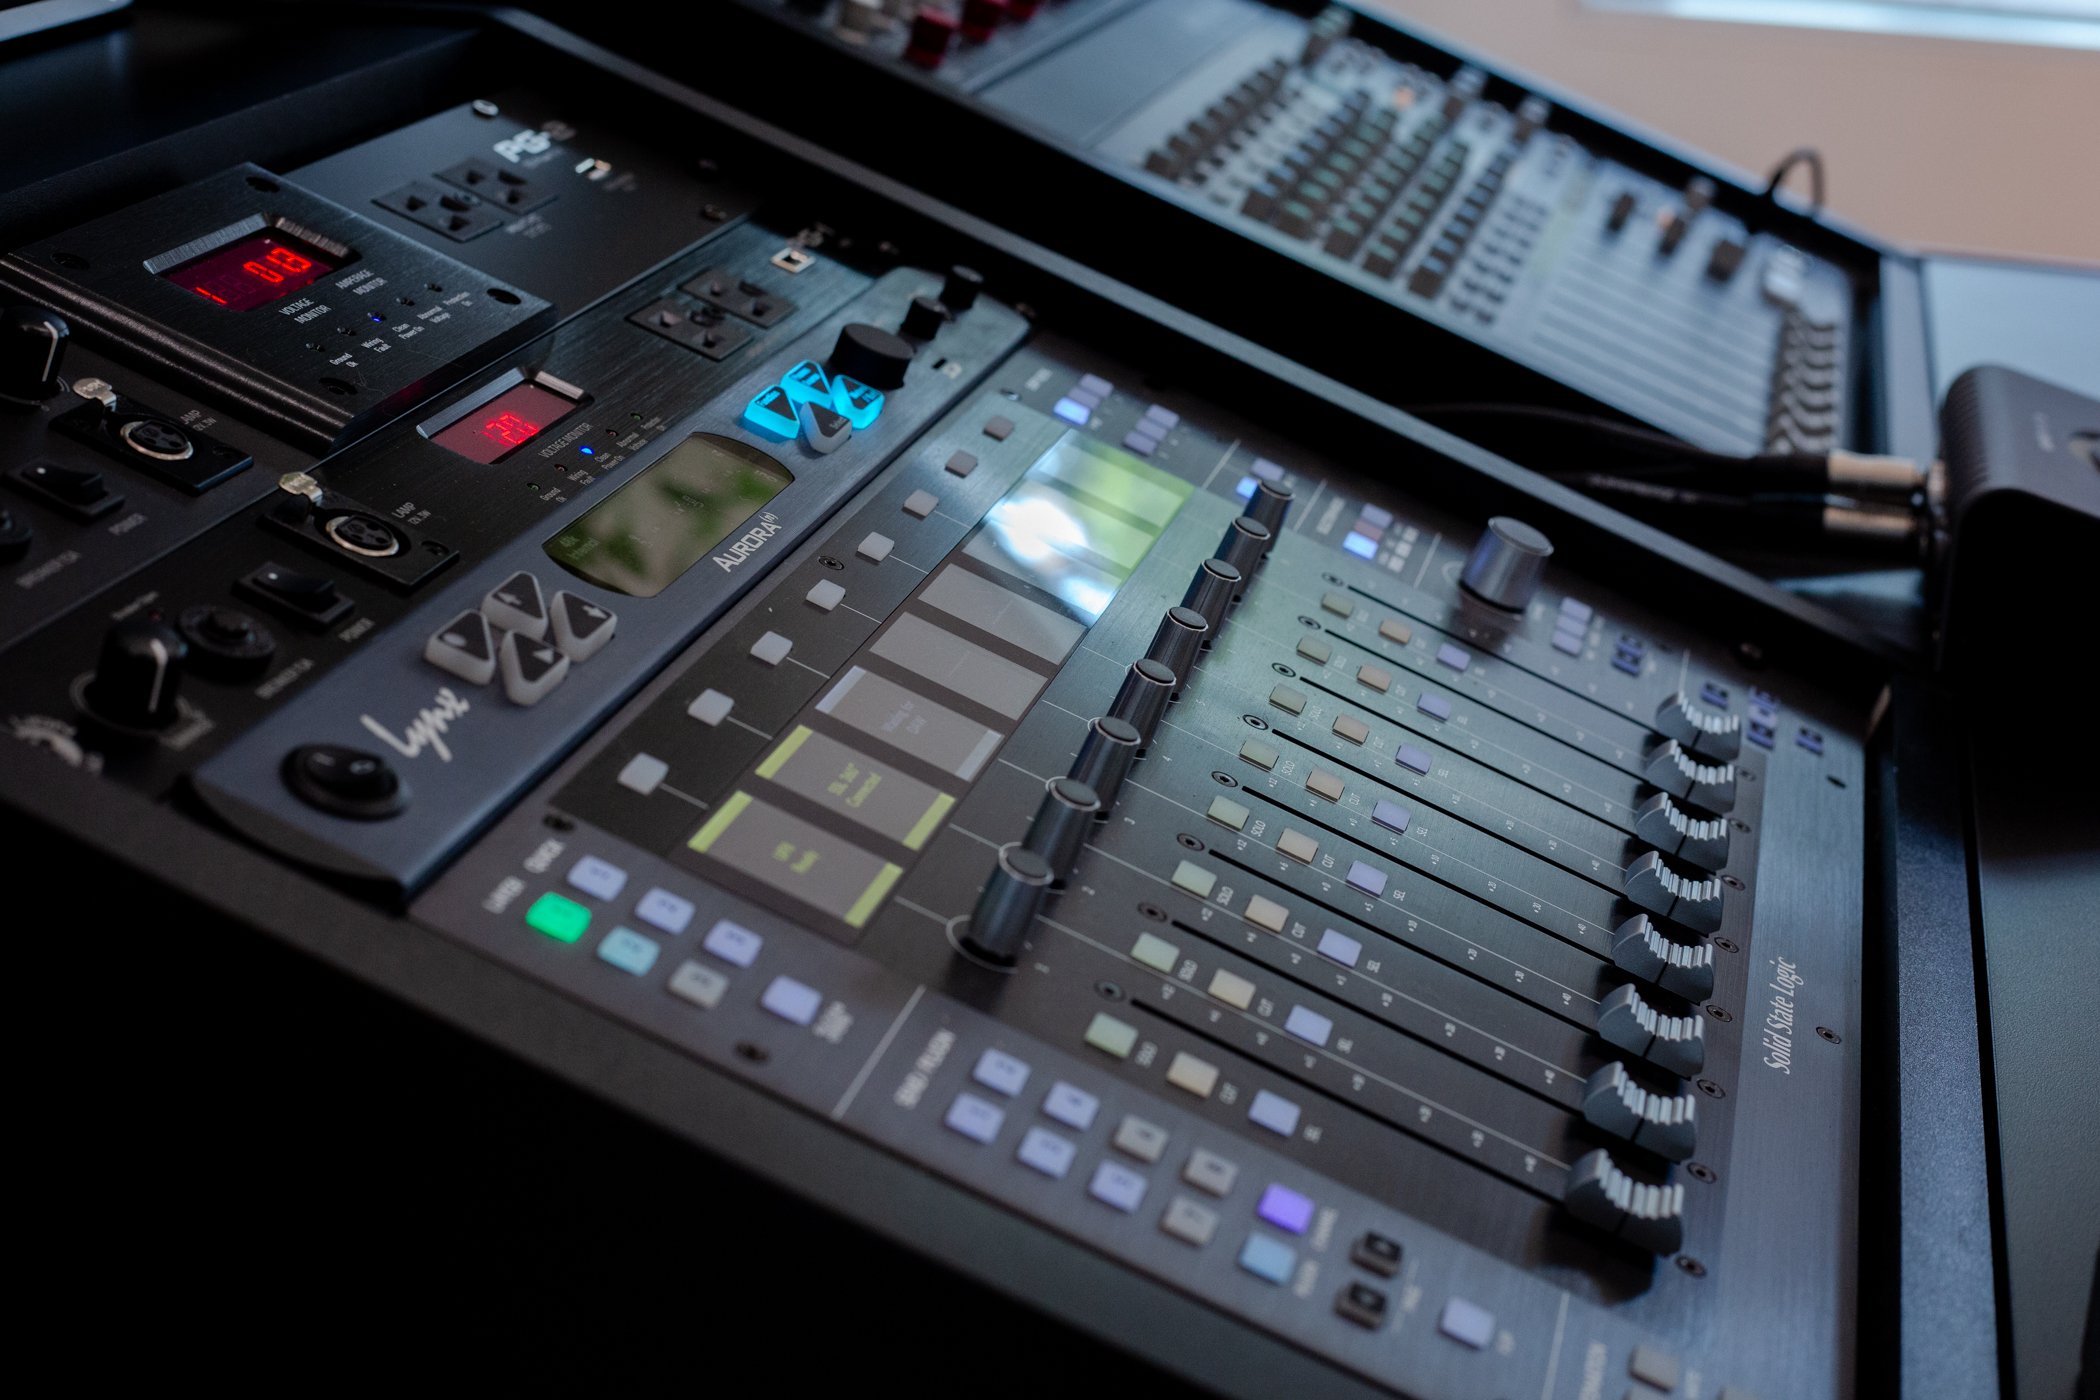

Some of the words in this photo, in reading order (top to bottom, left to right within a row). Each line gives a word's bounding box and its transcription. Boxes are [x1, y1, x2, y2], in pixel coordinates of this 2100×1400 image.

[335, 269, 375, 290] AMPERAGE
[353, 277, 388, 295] MONITOR
[279, 298, 314, 315] VOLTAGE
[294, 305, 332, 324] MONITOR
[361, 338, 384, 349] Wiring
[329, 353, 353, 365] Ground
[538, 438, 569, 458] VOLTAGE
[562, 423, 594, 445] MONITOR
[567, 469, 589, 482] Wiring
[540, 487, 561, 501] Ground
[391, 501, 417, 518] LAMP
[1281, 761, 1295, 775] SOLO
[1349, 793, 1360, 807] CUT
[1251, 820, 1266, 837] SOLO
[1417, 827, 1428, 836] SEL
[1322, 854, 1335, 868] CUT
[1393, 890, 1405, 901] SEL
[1769, 956, 1804, 998] Logic
[1766, 995, 1794, 1035] State
[1763, 1029, 1792, 1075] Solid
